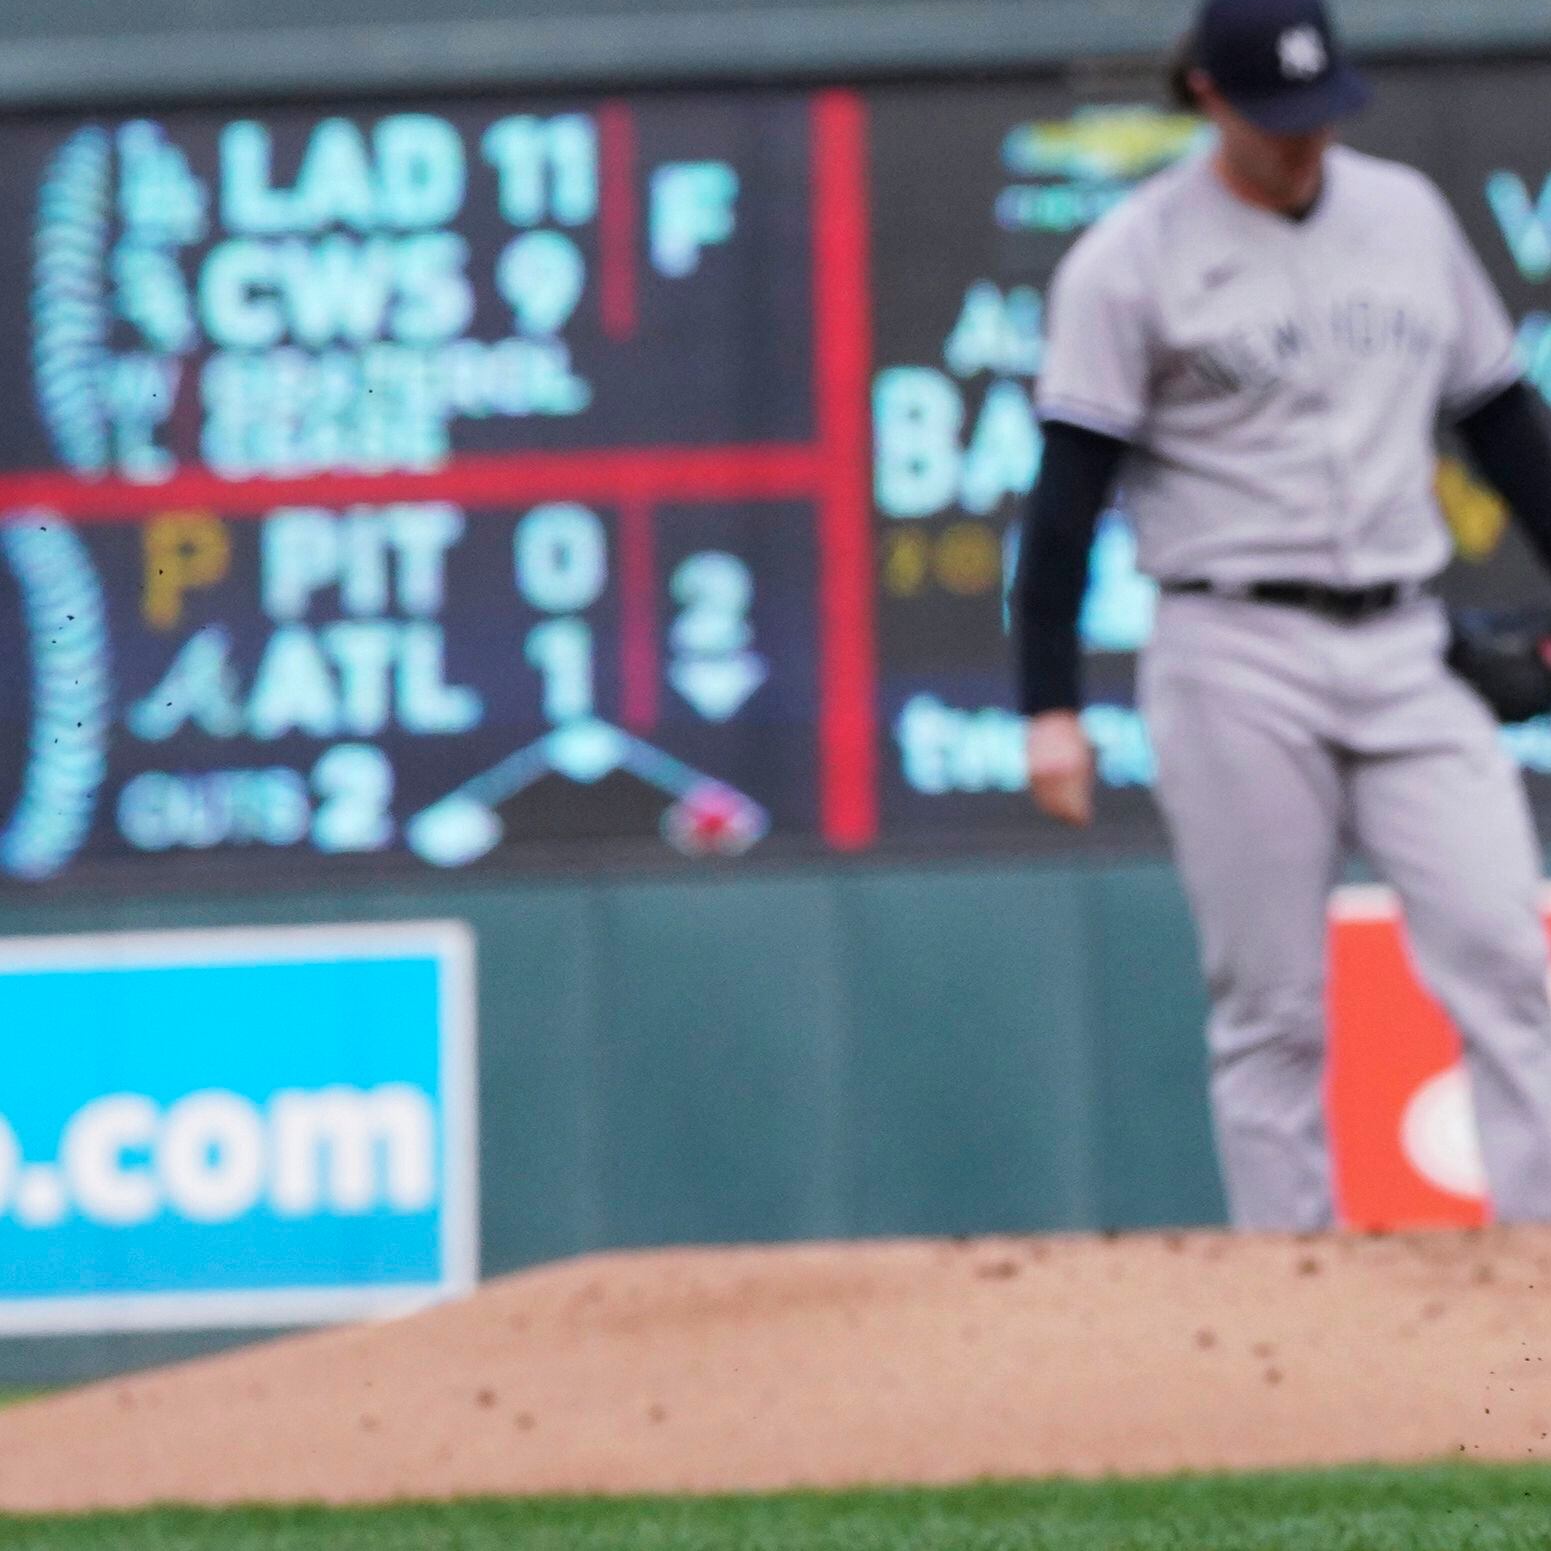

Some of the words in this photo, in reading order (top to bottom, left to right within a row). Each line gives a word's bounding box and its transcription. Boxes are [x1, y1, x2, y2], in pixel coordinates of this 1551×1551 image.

[219, 113, 467, 234] LAD
[482, 113, 598, 225] 11
[648, 160, 740, 279] F
[200, 229, 475, 347] CWS
[259, 502, 466, 621] PIT
[512, 500, 608, 613] 0
[243, 619, 485, 741] ATL
[524, 616, 598, 727] 1
[0, 1083, 437, 1231] .com
